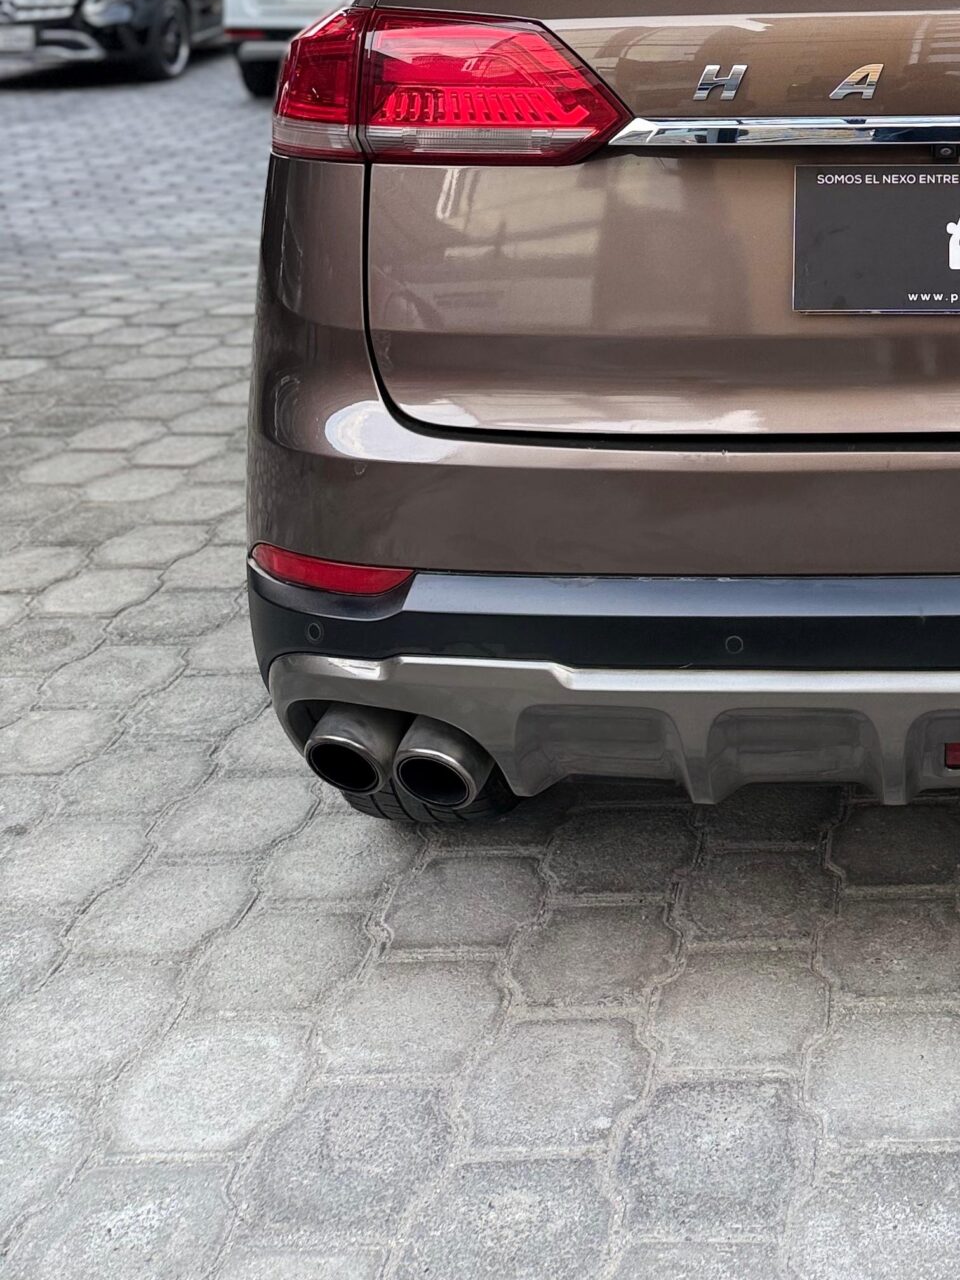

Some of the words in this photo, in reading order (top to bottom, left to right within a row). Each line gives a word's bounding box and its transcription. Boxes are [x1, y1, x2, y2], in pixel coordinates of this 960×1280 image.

[817, 174, 862, 184] SOMOS
[865, 174, 880, 184] EL
[882, 174, 916, 184] NEXO
[919, 174, 959, 184] ENTRE
